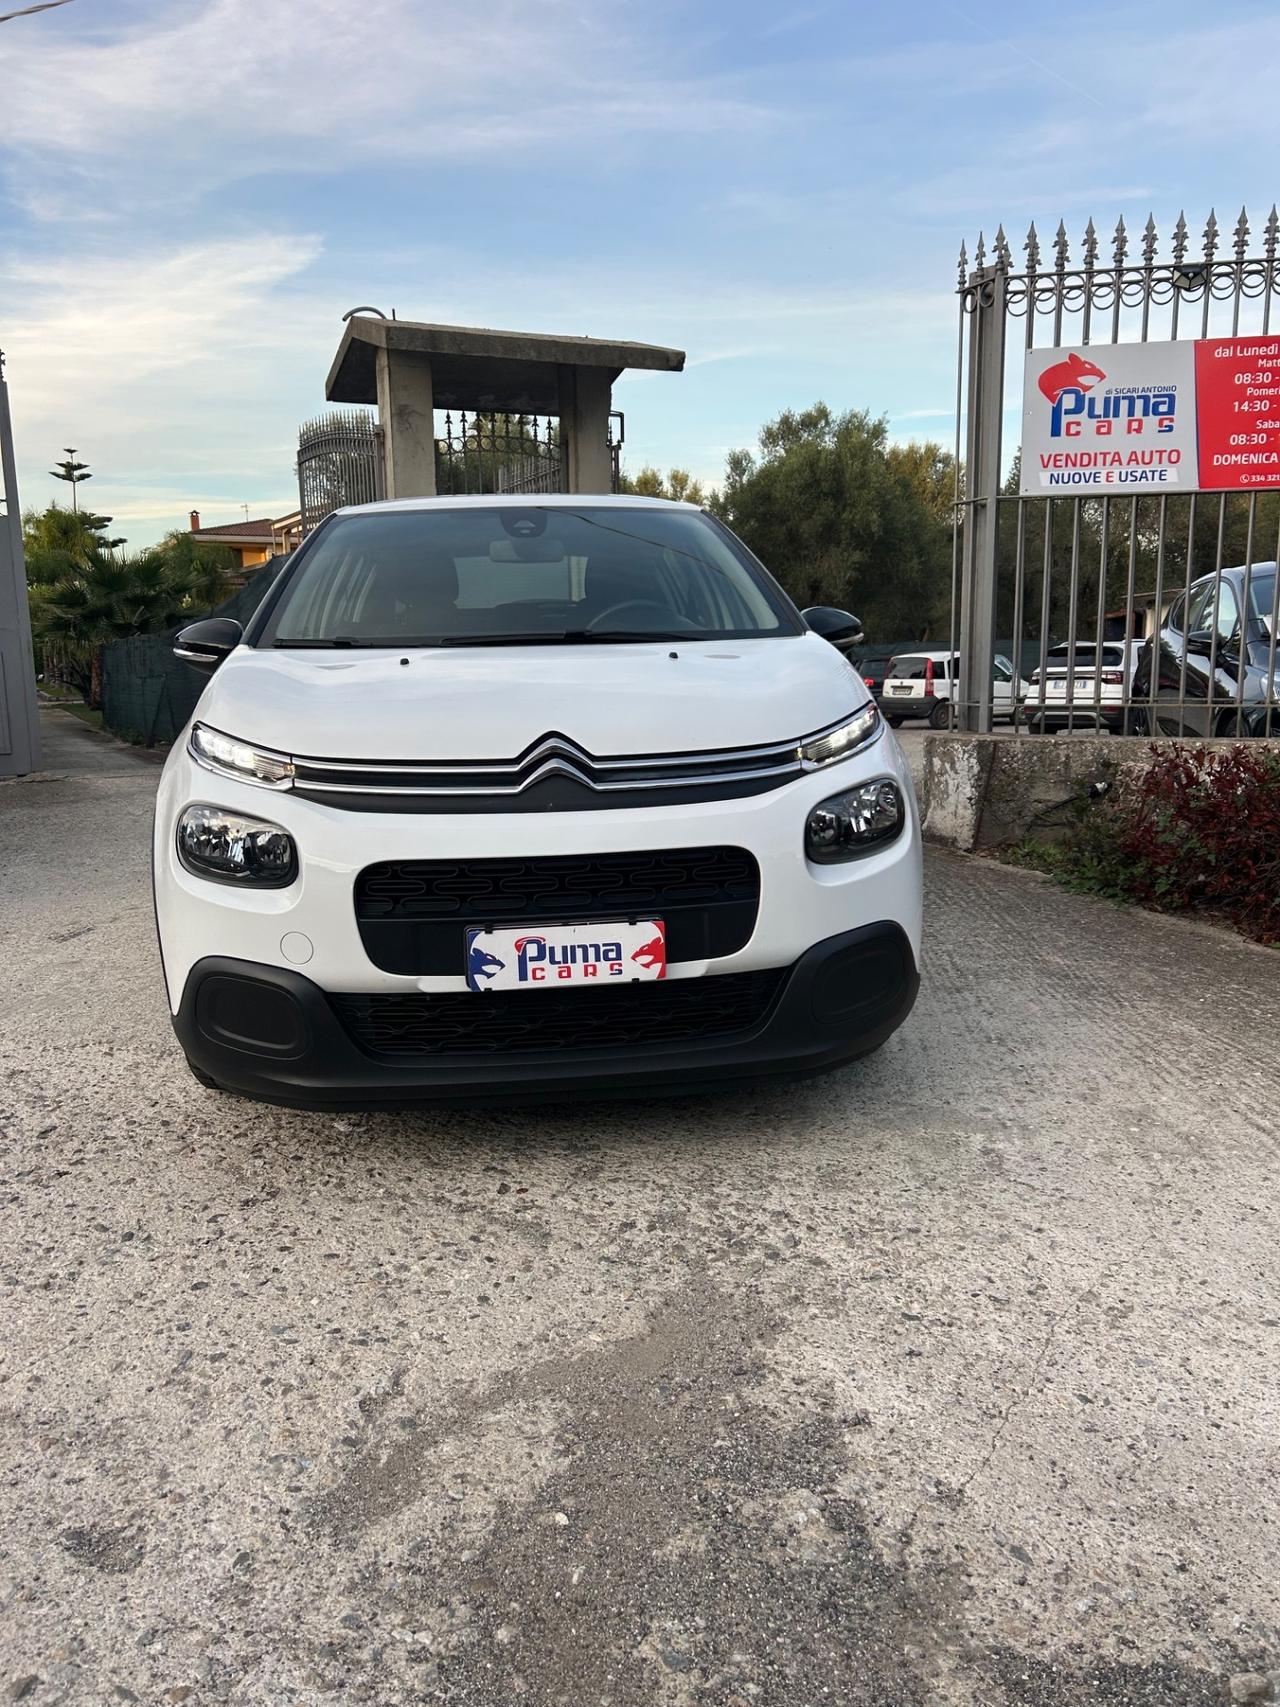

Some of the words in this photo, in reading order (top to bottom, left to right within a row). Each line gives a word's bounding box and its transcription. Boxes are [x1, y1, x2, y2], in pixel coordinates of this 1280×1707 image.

[1214, 346, 1233, 358] dal
[1236, 343, 1279, 357] Lunedì
[1234, 372, 1272, 385] 08:30
[1105, 388, 1113, 396] di
[1114, 386, 1140, 395] SICARI
[1050, 388, 1176, 438] Puma
[1233, 400, 1270, 413] 14:30
[1229, 433, 1267, 446] 08:30
[1040, 451, 1123, 469] VENDITA
[1126, 449, 1181, 466] AUTO
[1213, 452, 1279, 466] DOMENICA
[1049, 471, 1102, 485] NUOVE
[1105, 471, 1115, 483] E
[1118, 469, 1168, 482] USATE
[518, 939, 622, 982] Puma
